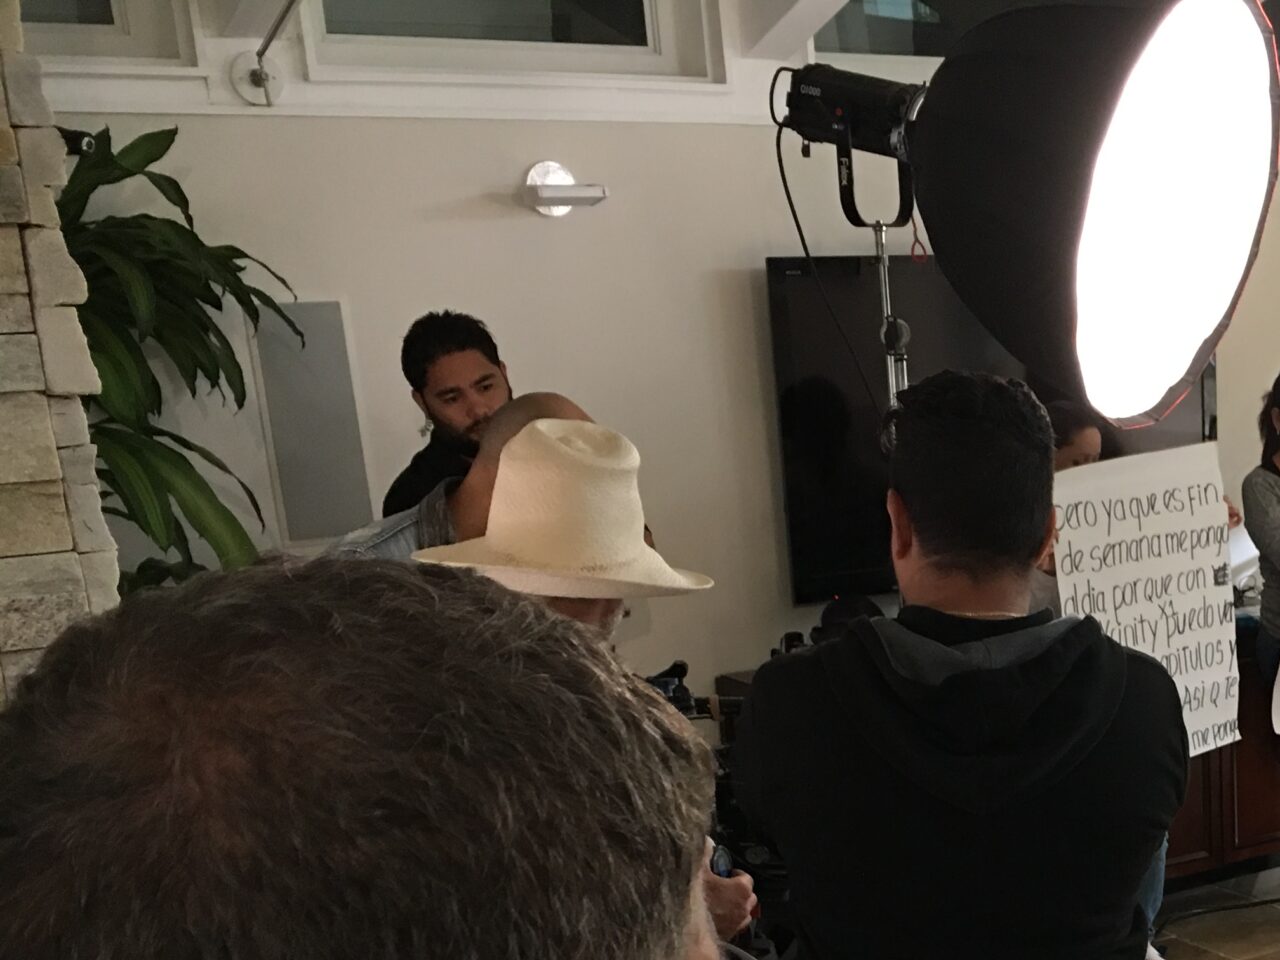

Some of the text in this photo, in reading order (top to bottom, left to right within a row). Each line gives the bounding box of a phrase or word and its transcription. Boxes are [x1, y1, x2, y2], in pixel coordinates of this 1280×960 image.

[1061, 540, 1084, 576] de
[1165, 528, 1188, 556] me
[1177, 567, 1206, 593] con
